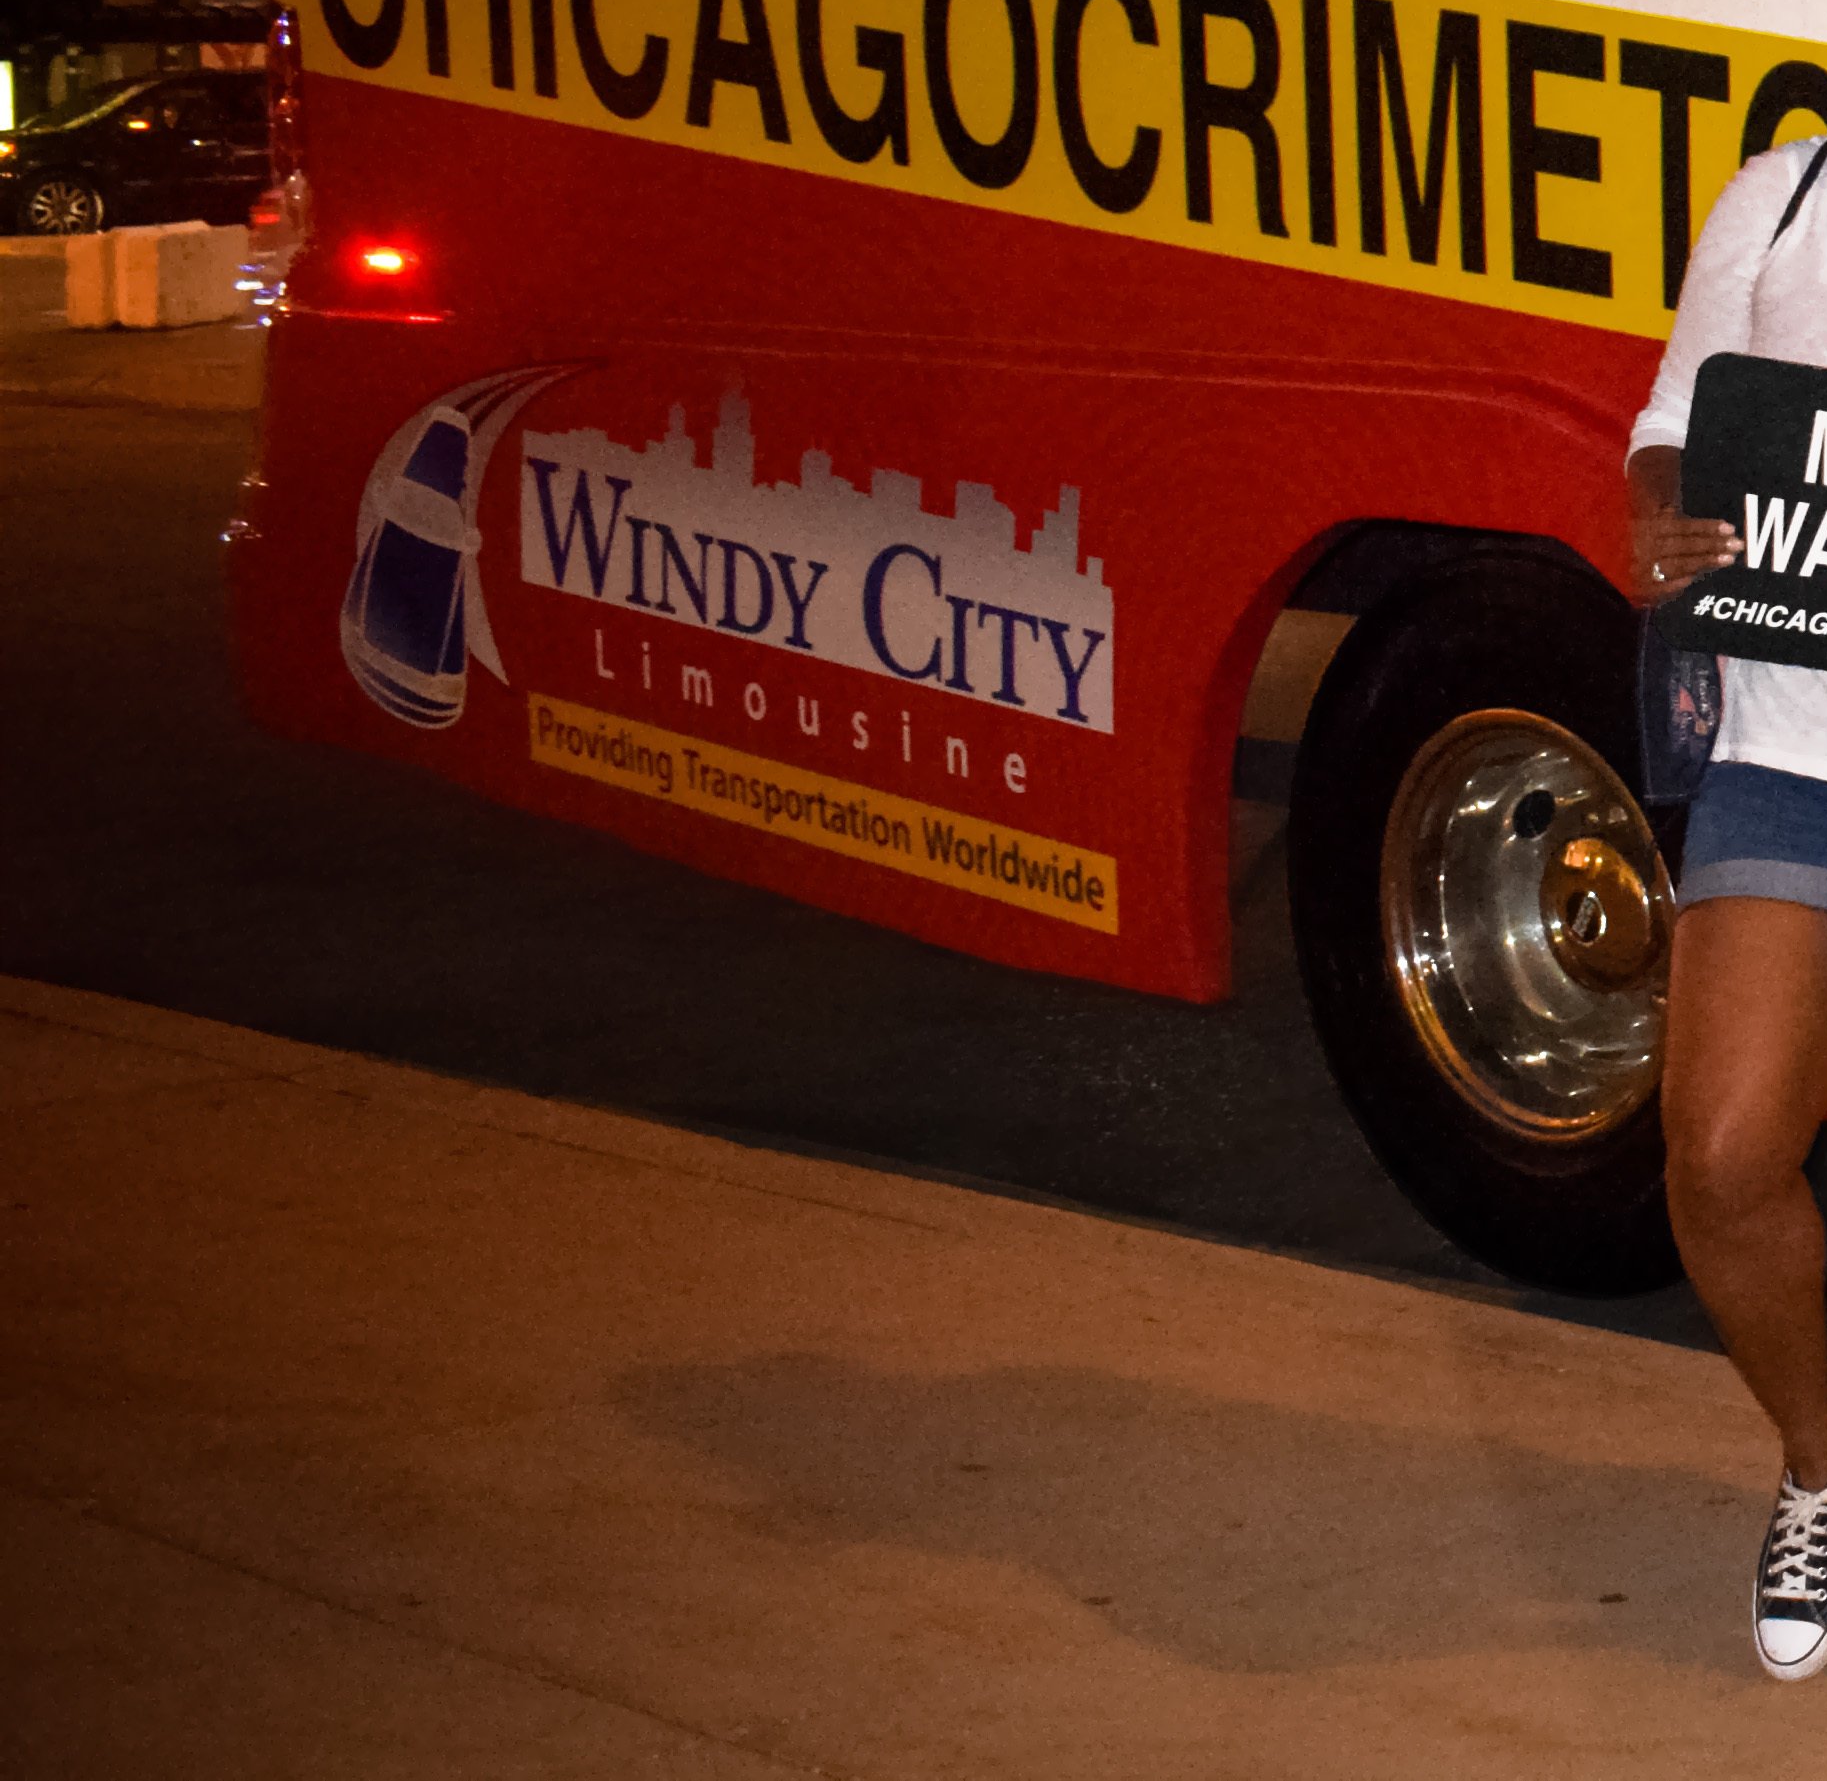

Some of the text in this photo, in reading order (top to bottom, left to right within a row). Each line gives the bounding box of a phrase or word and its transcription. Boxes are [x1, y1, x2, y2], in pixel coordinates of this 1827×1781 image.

[526, 456, 1106, 723] WINDY CITY
[536, 705, 1106, 912] Providing Transportation Worldwide
[595, 628, 1028, 794] Limousine
